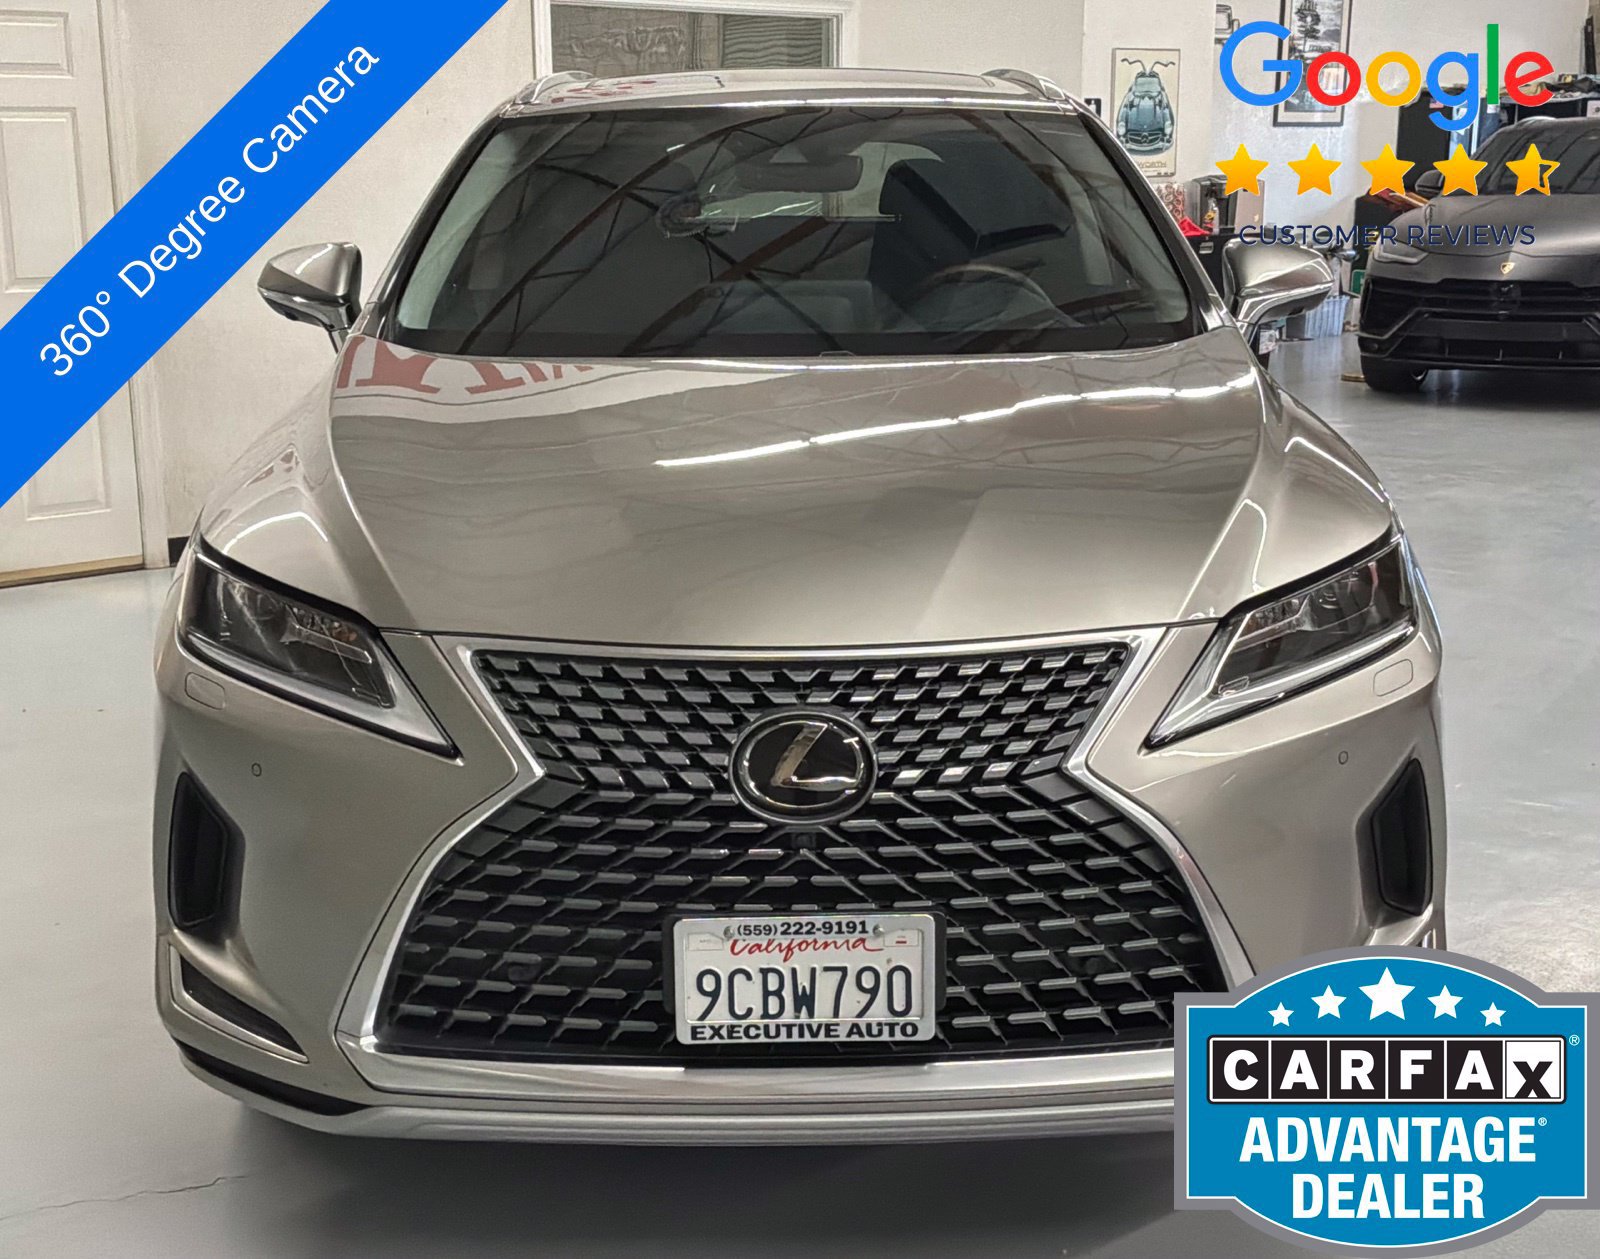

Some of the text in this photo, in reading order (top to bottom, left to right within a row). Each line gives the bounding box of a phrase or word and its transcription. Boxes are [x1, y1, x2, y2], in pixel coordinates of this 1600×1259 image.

[737, 920, 869, 937] (559) 222-9191
[730, 937, 884, 963] California
[696, 964, 913, 1021] 9CBW790
[690, 1022, 919, 1041] EXECUTIVE AUTO
